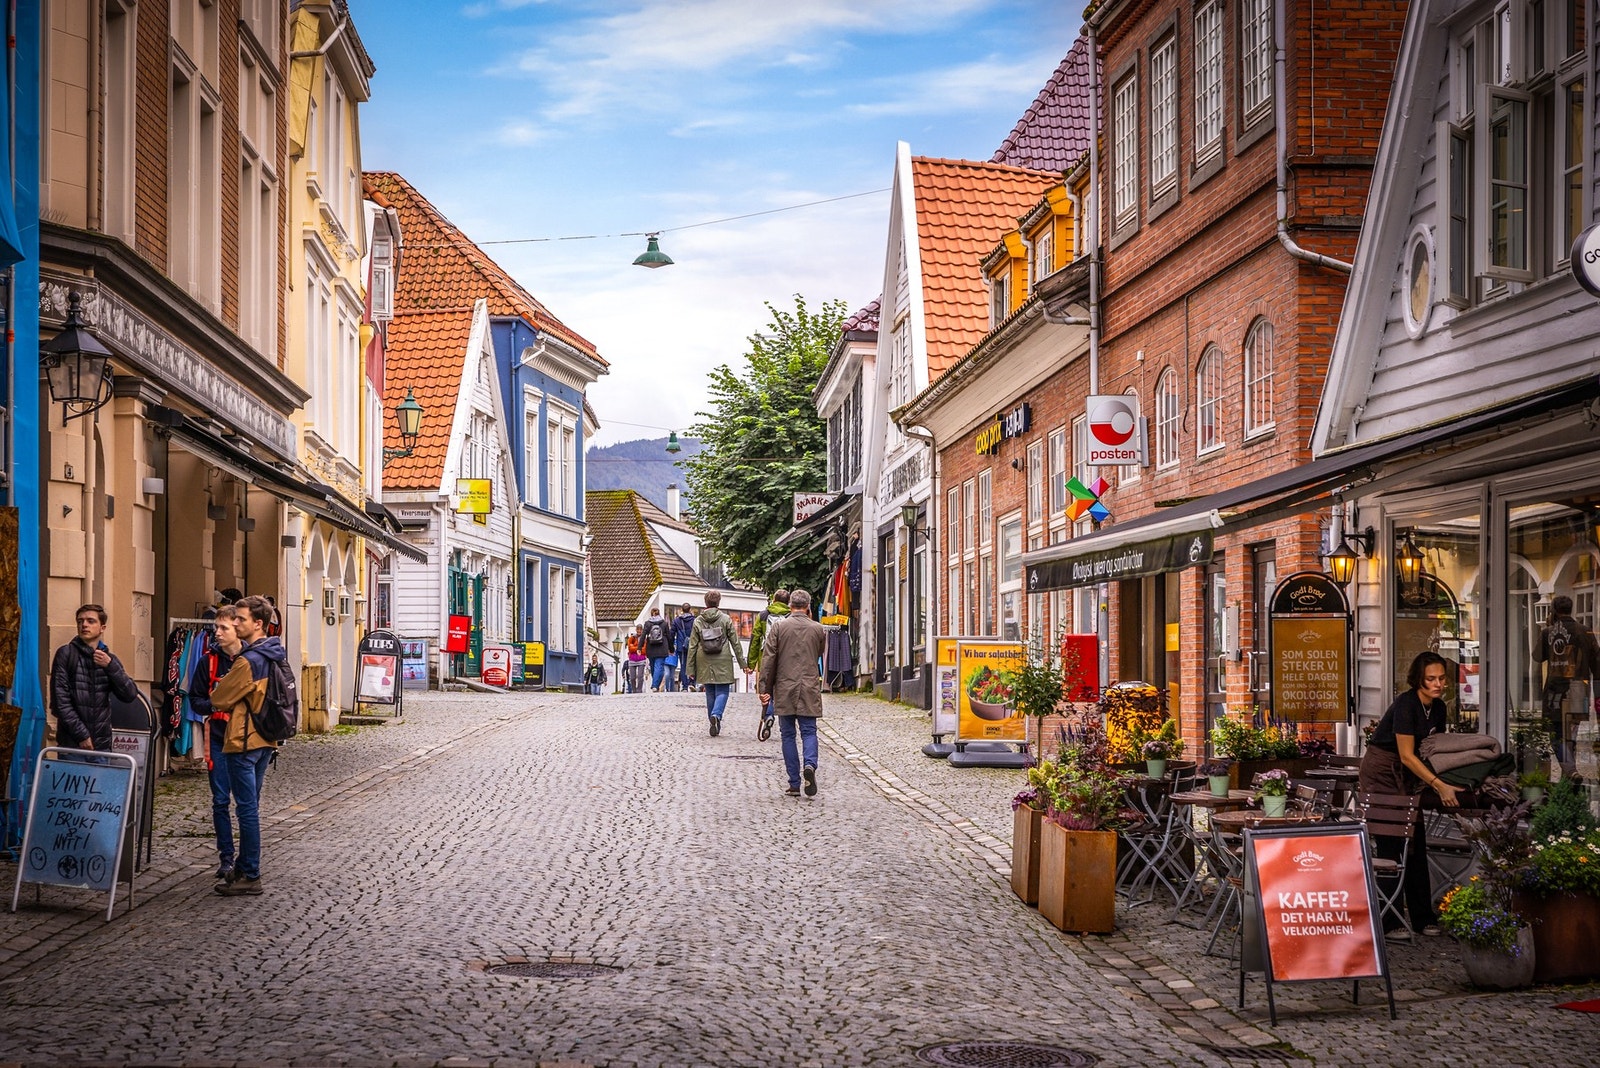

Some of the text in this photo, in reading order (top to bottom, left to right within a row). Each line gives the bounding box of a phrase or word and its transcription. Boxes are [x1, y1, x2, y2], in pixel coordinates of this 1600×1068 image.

[1091, 448, 1136, 462] posten
[796, 497, 830, 510] MARKE
[796, 512, 813, 520] BA
[1290, 586, 1326, 600] Godt Brød
[964, 650, 972, 658] Vi
[974, 650, 987, 658] har
[1282, 650, 1338, 659] SOM SOLEN
[1282, 661, 1338, 671] STEKER VI
[1308, 673, 1338, 681] DAGEN
[1282, 690, 1339, 700] ØKOLOGISK
[112, 742, 139, 751] Bergen
[52, 771, 102, 796] VINYL
[46, 798, 121, 818] STORT UTVALG
[54, 811, 100, 830] BRUKT
[1293, 851, 1324, 862] Godt Brød
[1278, 891, 1349, 909] KAFFE?
[1281, 912, 1352, 923] DET HAR VI,
[1282, 926, 1353, 936] VELKOMMEN!
